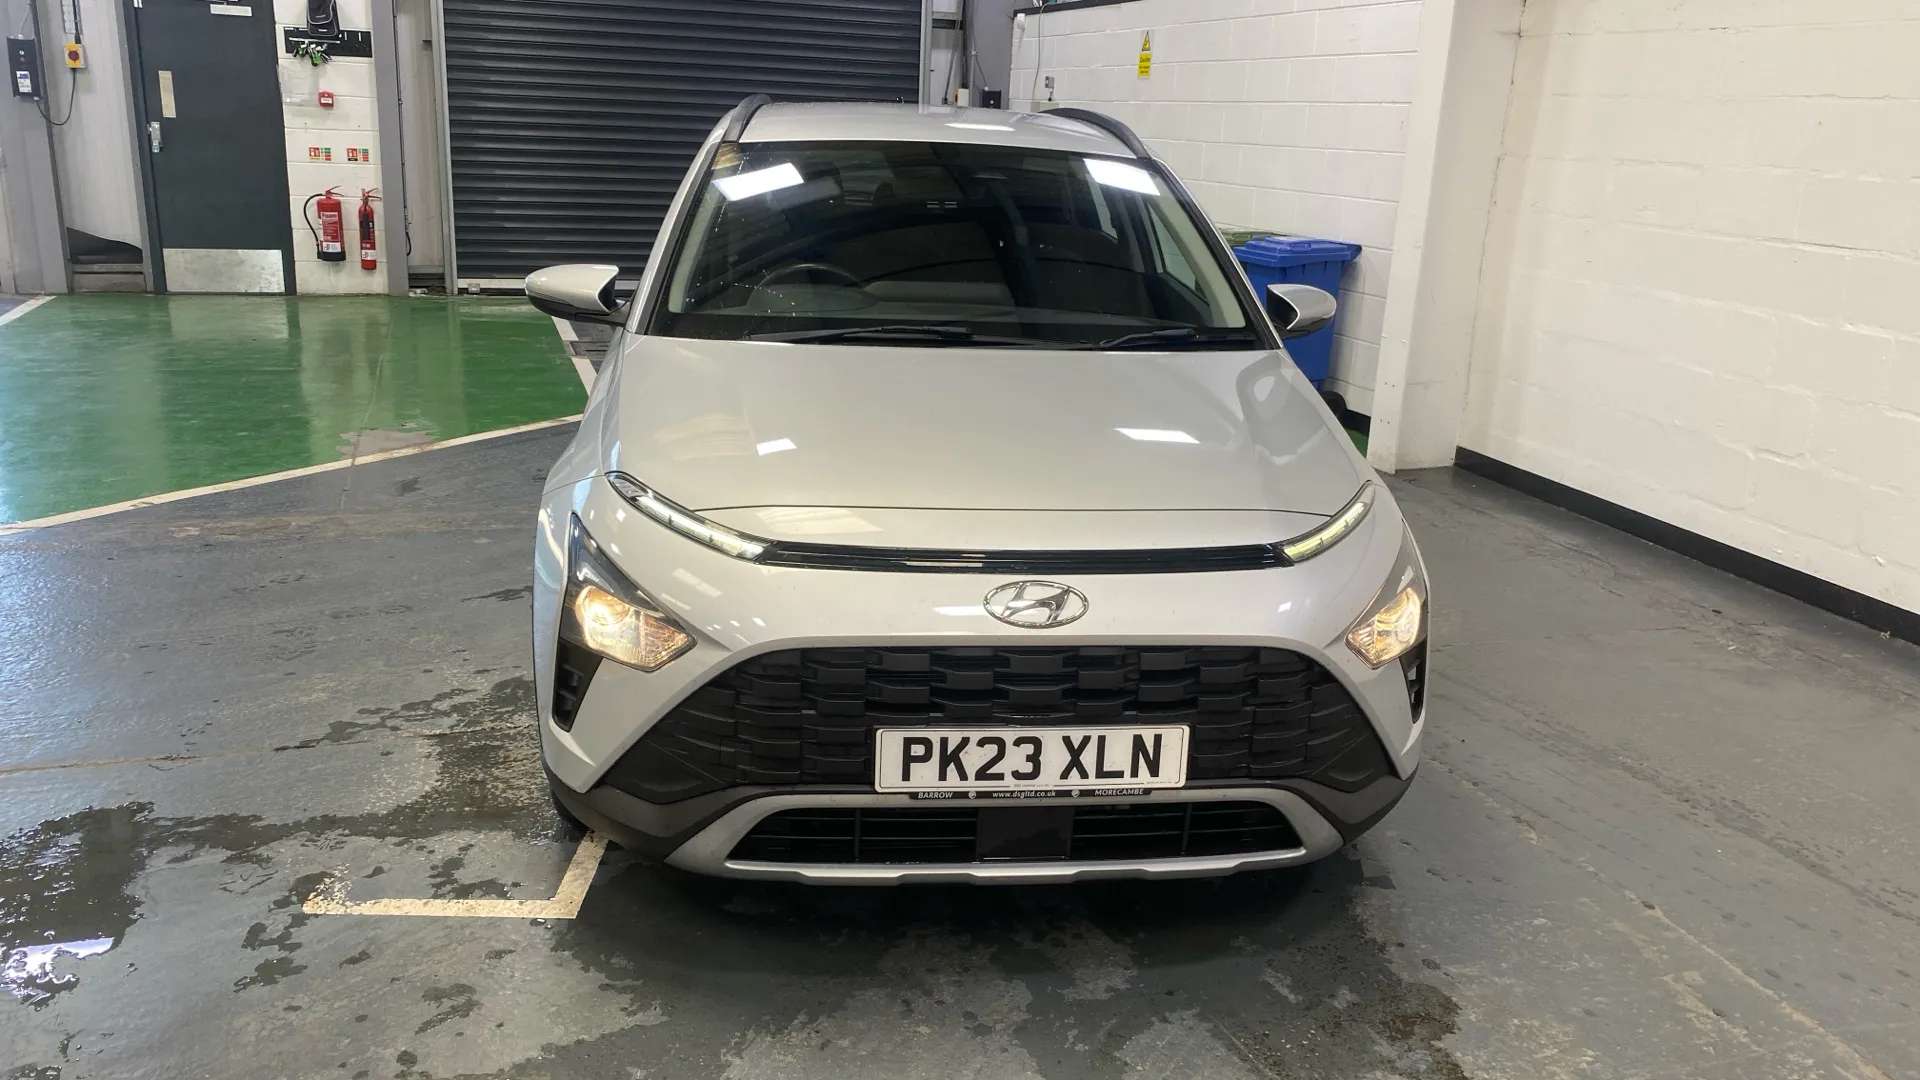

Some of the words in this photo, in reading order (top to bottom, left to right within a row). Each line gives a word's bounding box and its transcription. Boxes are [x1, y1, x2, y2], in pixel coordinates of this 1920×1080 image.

[902, 736, 1043, 782] PK23
[1059, 734, 1163, 780] XLN
[918, 791, 953, 799] BARROW
[992, 790, 1056, 799] www.dsgltd.co.uk
[1094, 788, 1144, 797] MORECAMBE
